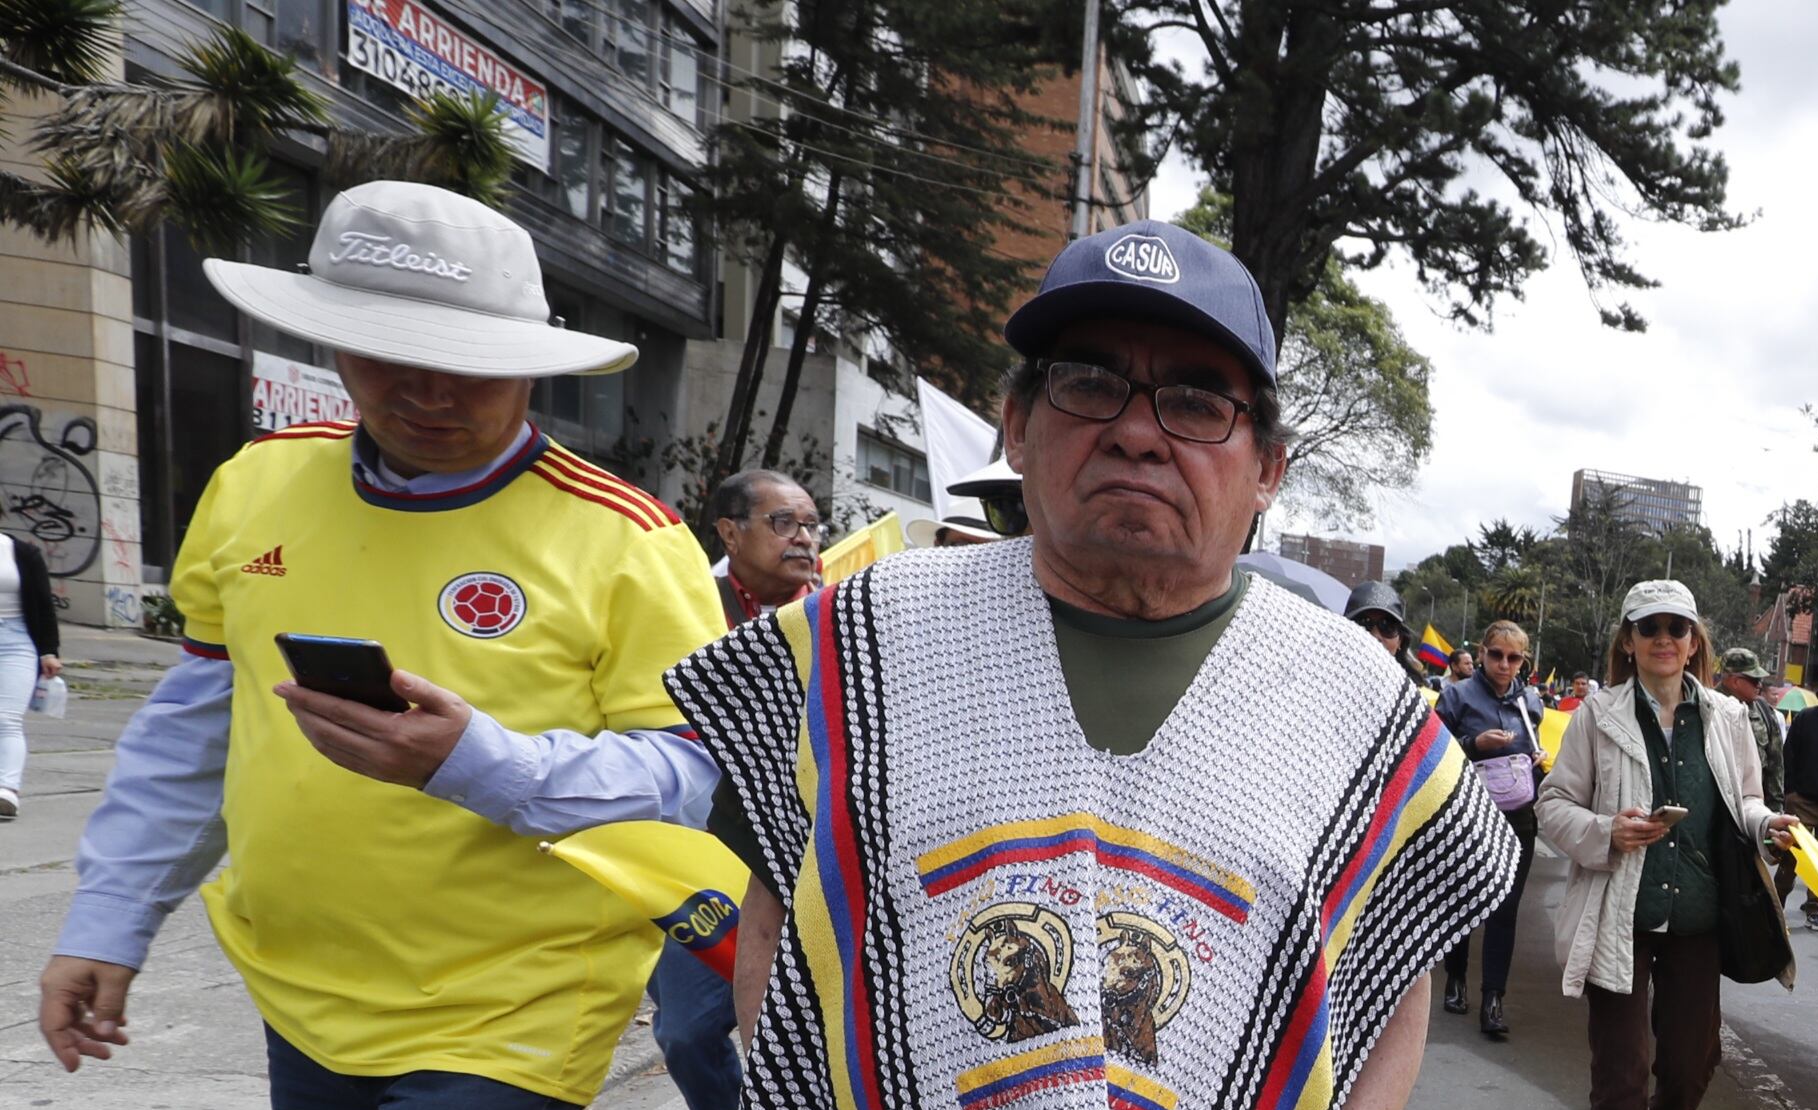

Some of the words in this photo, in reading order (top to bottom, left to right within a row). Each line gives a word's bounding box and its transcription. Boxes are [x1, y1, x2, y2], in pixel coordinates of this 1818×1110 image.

[398, 3, 528, 110] ARRIENDA
[329, 231, 472, 281] Titleist
[1110, 241, 1174, 278] CASUR
[252, 379, 361, 421] ARRIENDA
[240, 563, 288, 577] adidas
[1006, 873, 1081, 906] FINO
